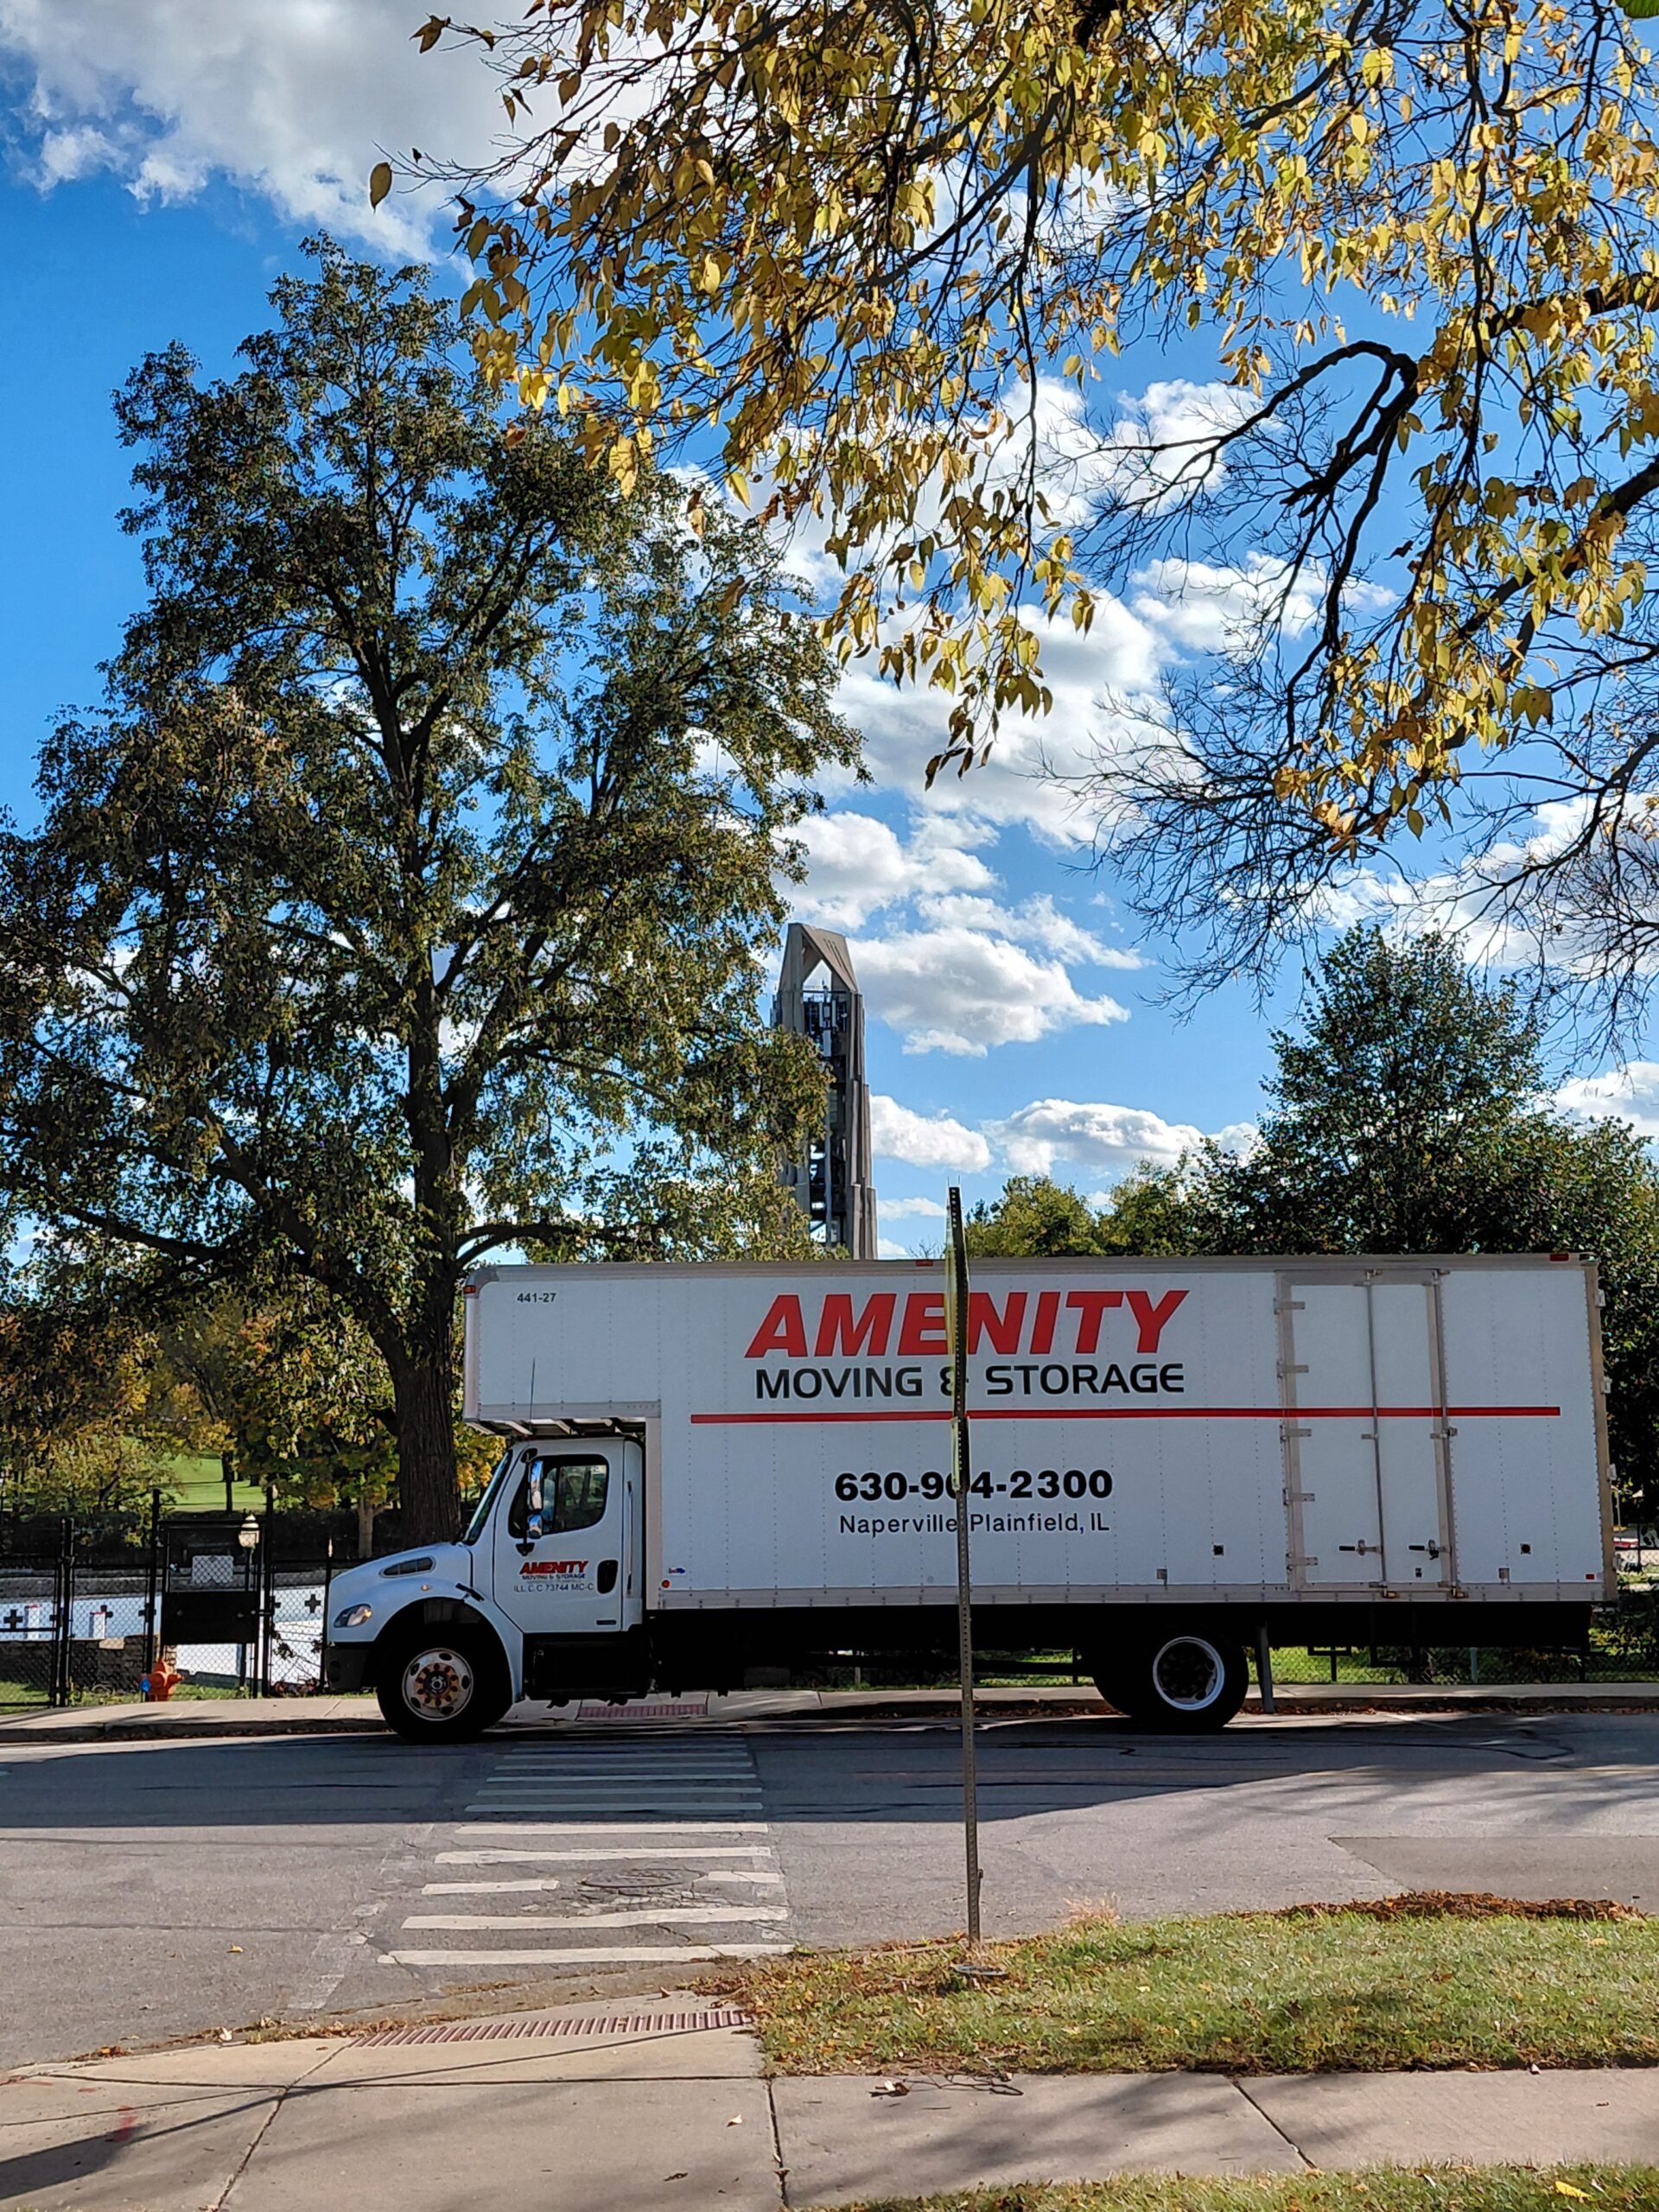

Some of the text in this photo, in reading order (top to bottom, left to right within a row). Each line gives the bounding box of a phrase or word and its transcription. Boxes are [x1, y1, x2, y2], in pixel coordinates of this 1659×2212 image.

[517, 1292, 556, 1303] 441-27
[744, 1290, 1190, 1358] AMENITY
[756, 1367, 923, 1399] MOVING
[985, 1363, 1185, 1395] STORAGE
[969, 1513, 1084, 1535] Plainfield,
[1090, 1513, 1109, 1531] IL
[519, 1560, 589, 1574] AMENITY
